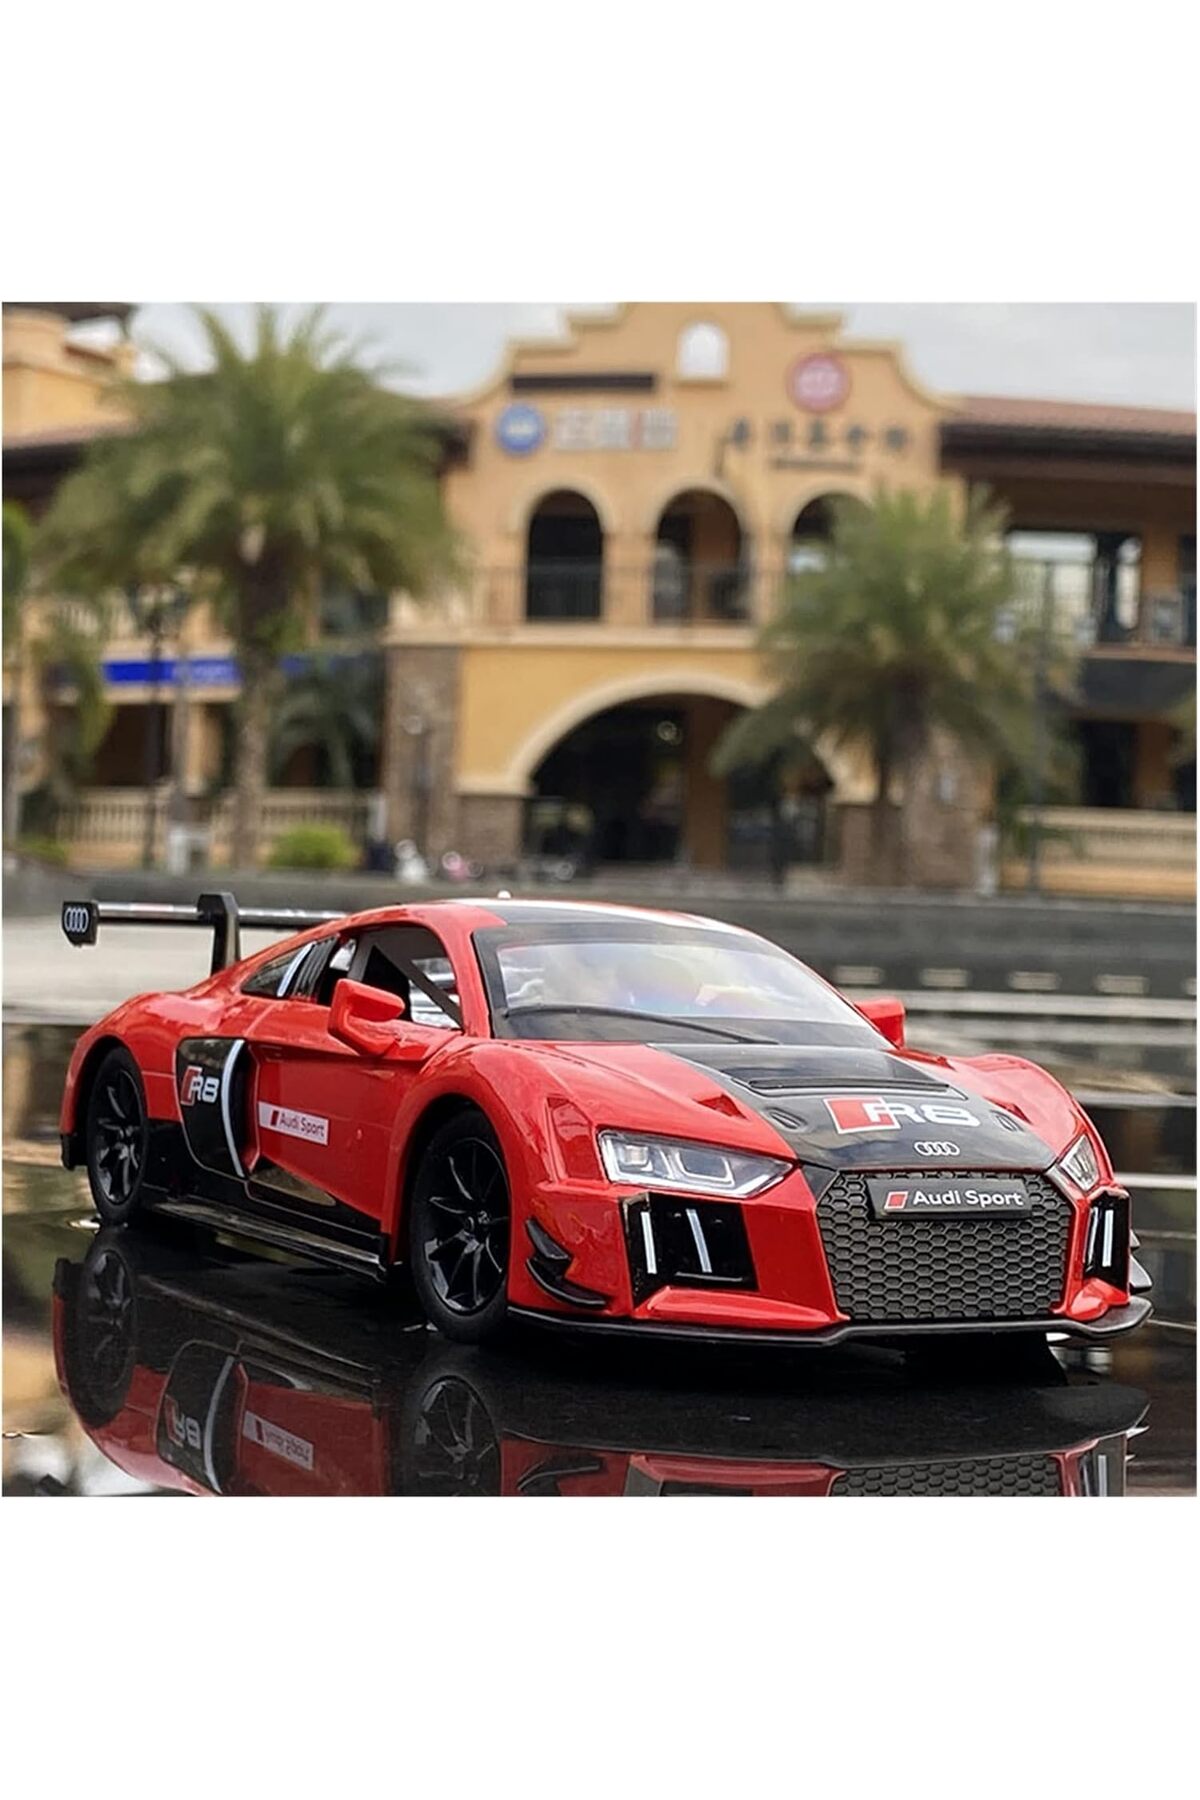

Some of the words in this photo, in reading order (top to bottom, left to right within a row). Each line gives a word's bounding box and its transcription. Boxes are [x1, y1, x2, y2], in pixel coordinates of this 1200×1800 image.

[188, 1075, 220, 1103] R8
[279, 1112, 300, 1130] Audi
[300, 1117, 325, 1138] Sport
[864, 1102, 981, 1127] R8
[912, 1189, 961, 1206] Audi
[964, 1190, 1024, 1208] Sport
